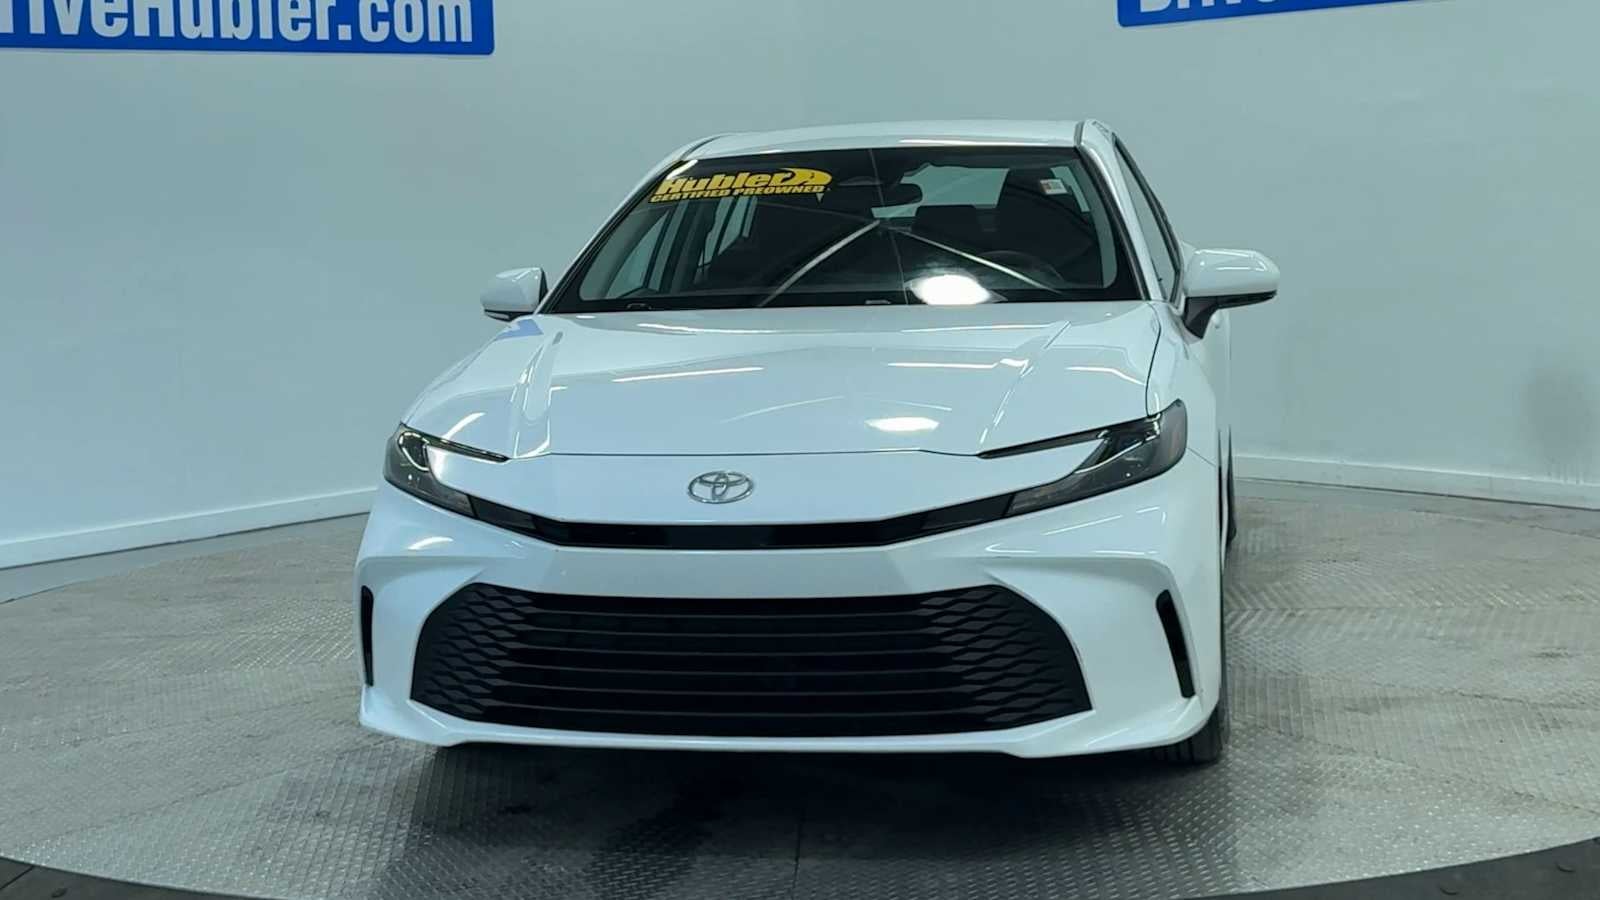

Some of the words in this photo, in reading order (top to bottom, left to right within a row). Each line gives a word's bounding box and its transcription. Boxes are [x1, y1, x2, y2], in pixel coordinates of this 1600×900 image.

[655, 171, 795, 195] Hubler
[650, 188, 730, 203] CERTIFIED
[732, 185, 825, 196] PREOWNED
